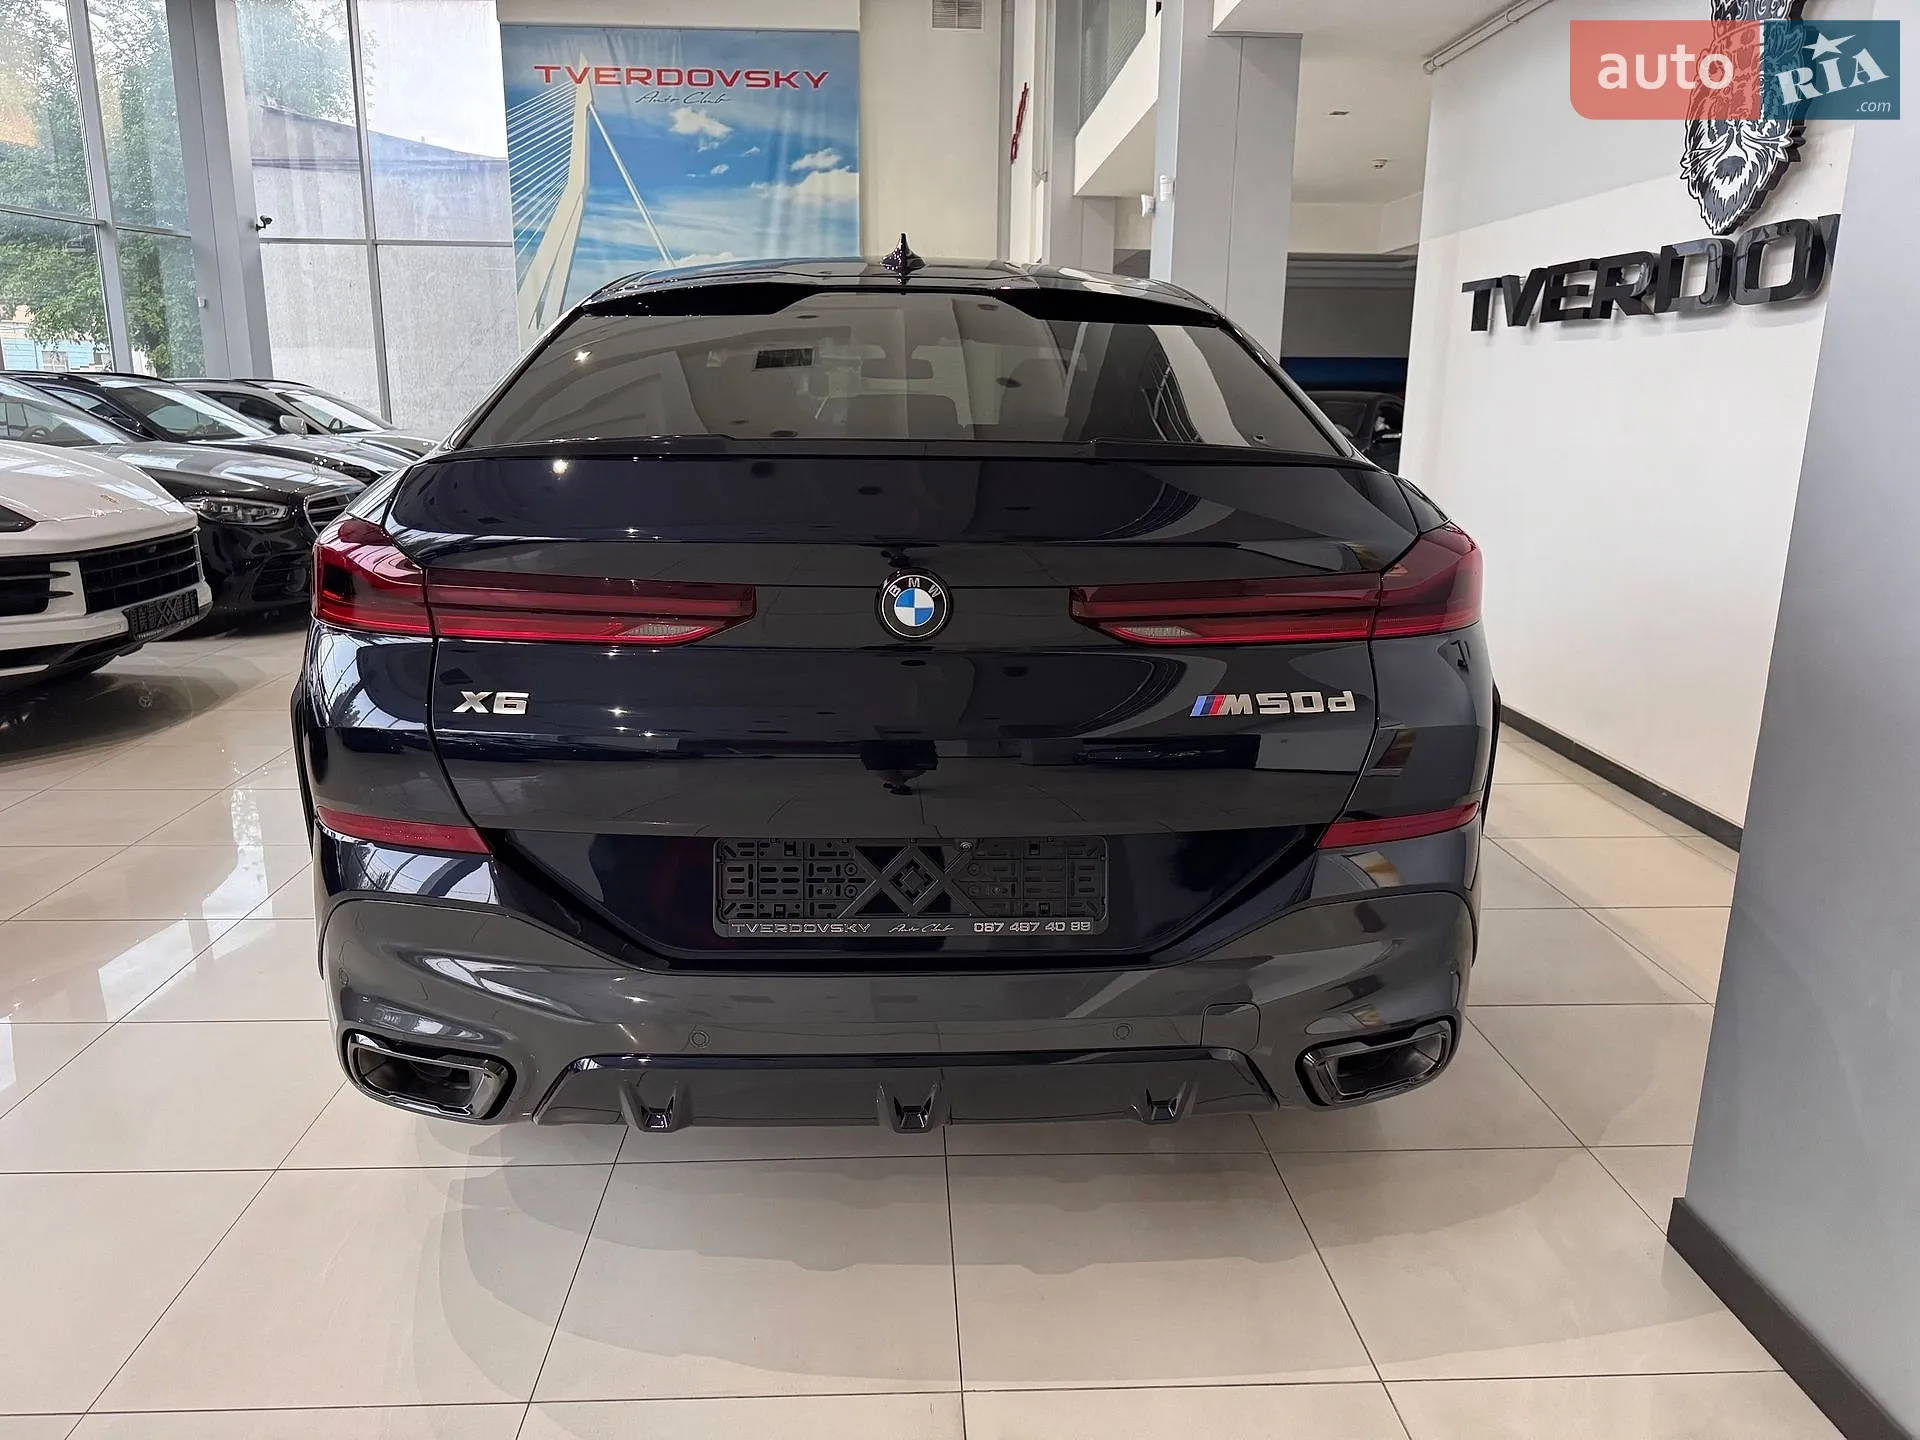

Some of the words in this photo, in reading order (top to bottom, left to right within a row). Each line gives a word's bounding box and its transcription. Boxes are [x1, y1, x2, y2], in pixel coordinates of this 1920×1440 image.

[533, 64, 829, 90] TVERDOVSKY
[1461, 213, 1841, 332] TVERDO
[888, 577, 942, 598] BMW
[452, 690, 530, 715] X6
[731, 922, 872, 934] TVERDOVSKY
